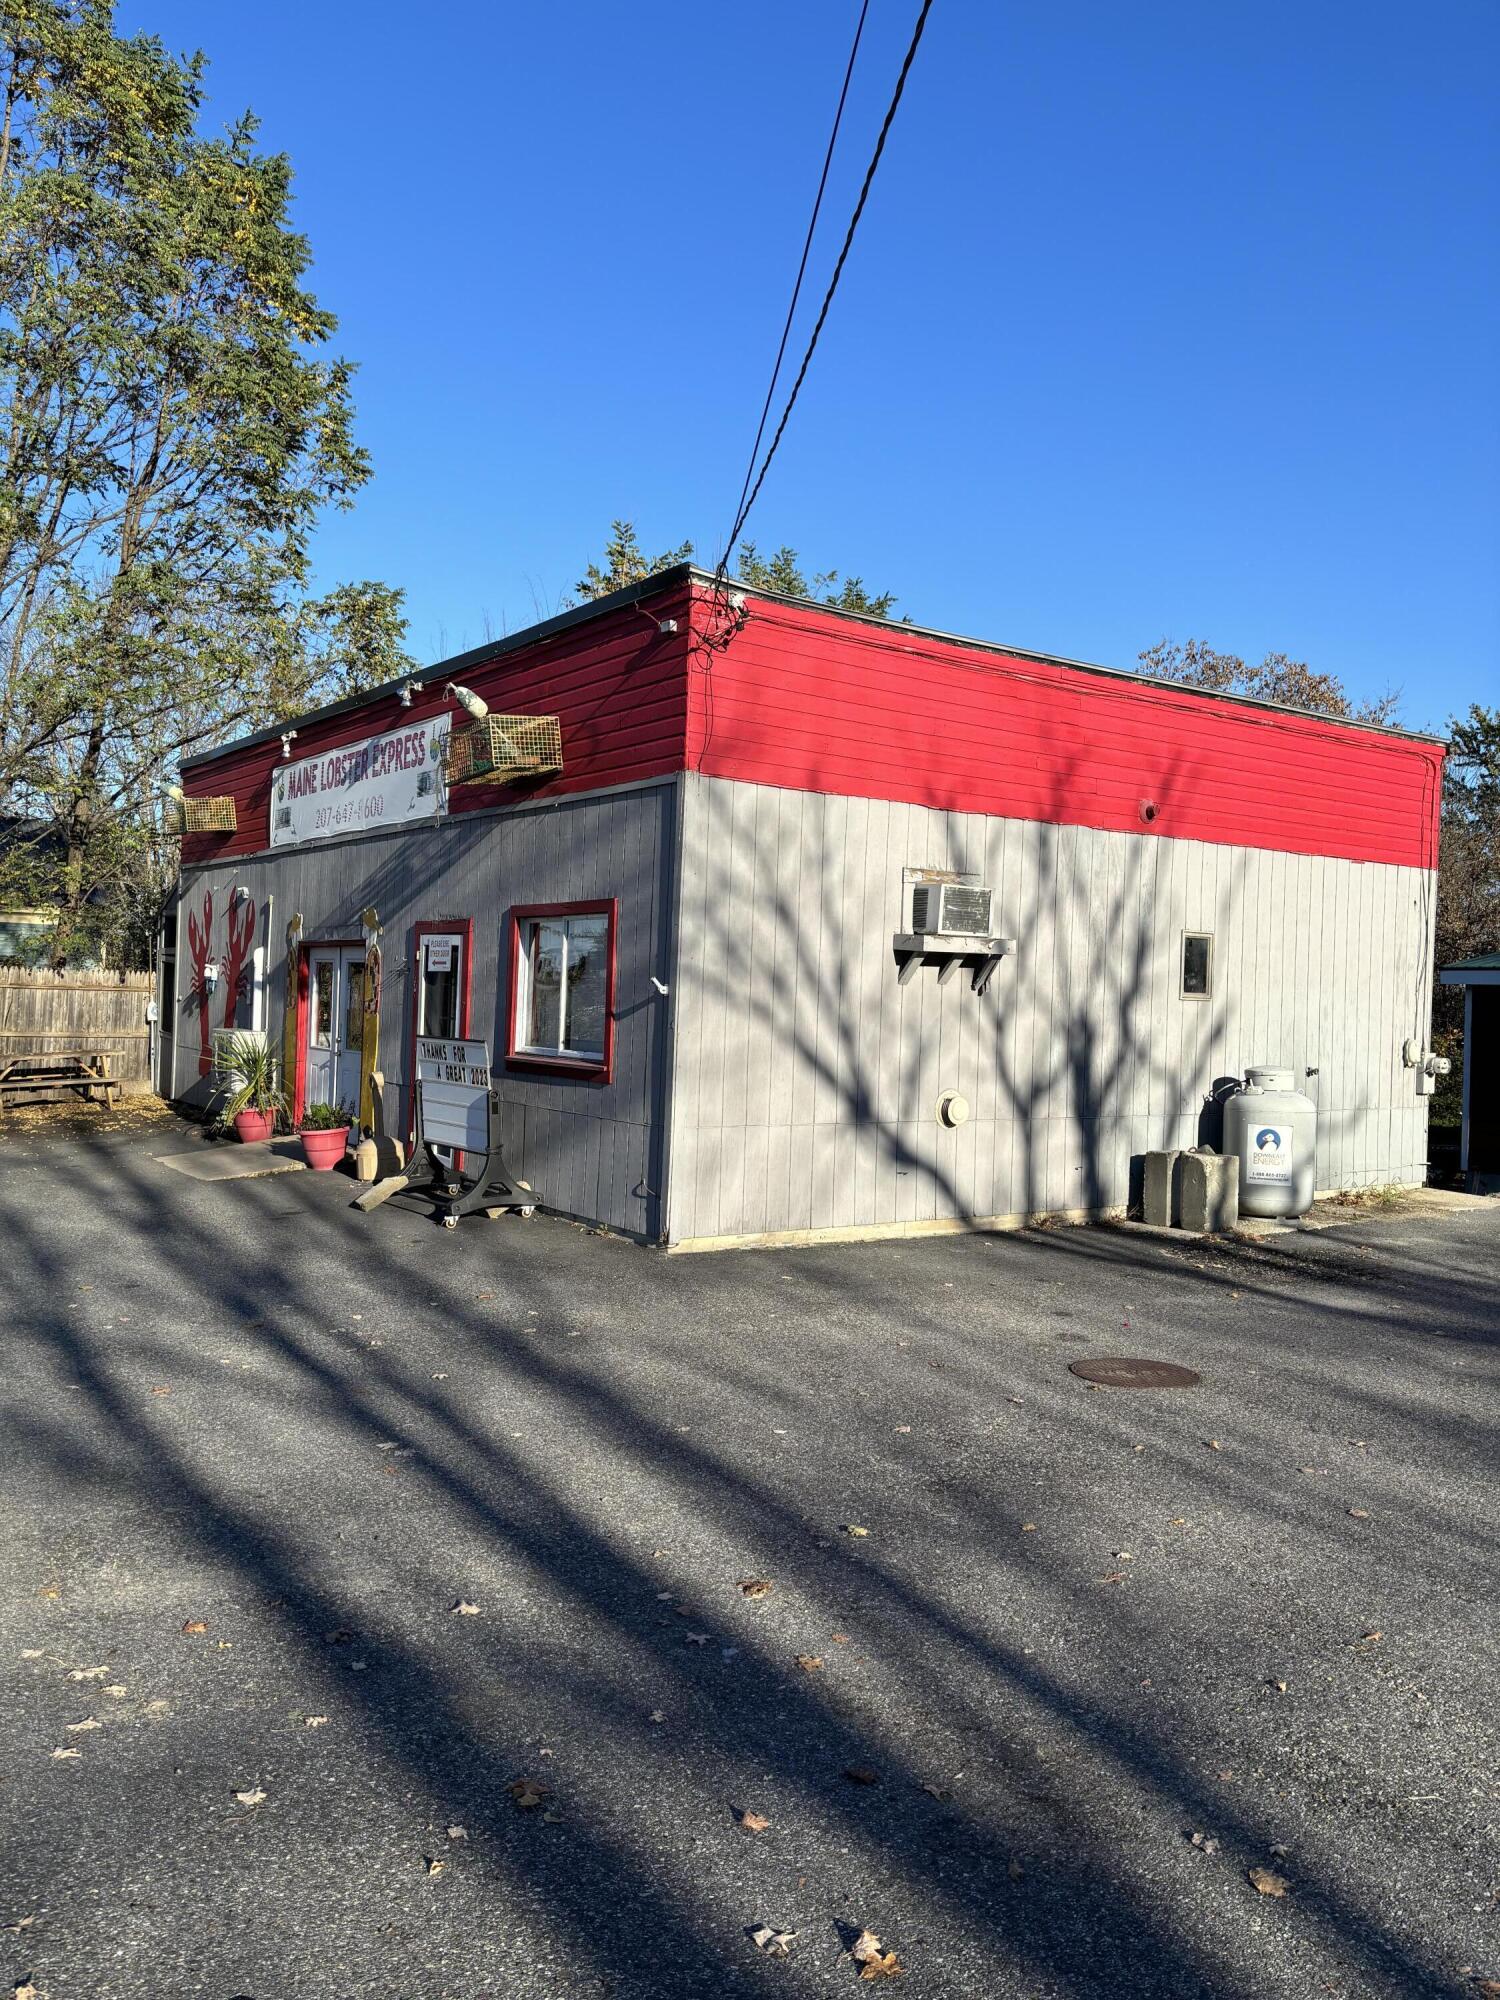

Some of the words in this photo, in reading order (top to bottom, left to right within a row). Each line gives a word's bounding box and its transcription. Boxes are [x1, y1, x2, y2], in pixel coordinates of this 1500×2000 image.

[288, 763, 318, 800] MAINE
[320, 748, 369, 791] LOBSTER
[371, 730, 426, 778] EXPRESS
[422, 1042, 447, 1061] THANKS
[453, 1046, 466, 1063] FOR
[437, 1063, 442, 1080] A
[445, 1065, 467, 1083] GREAT
[470, 1067, 489, 1087] 2023
